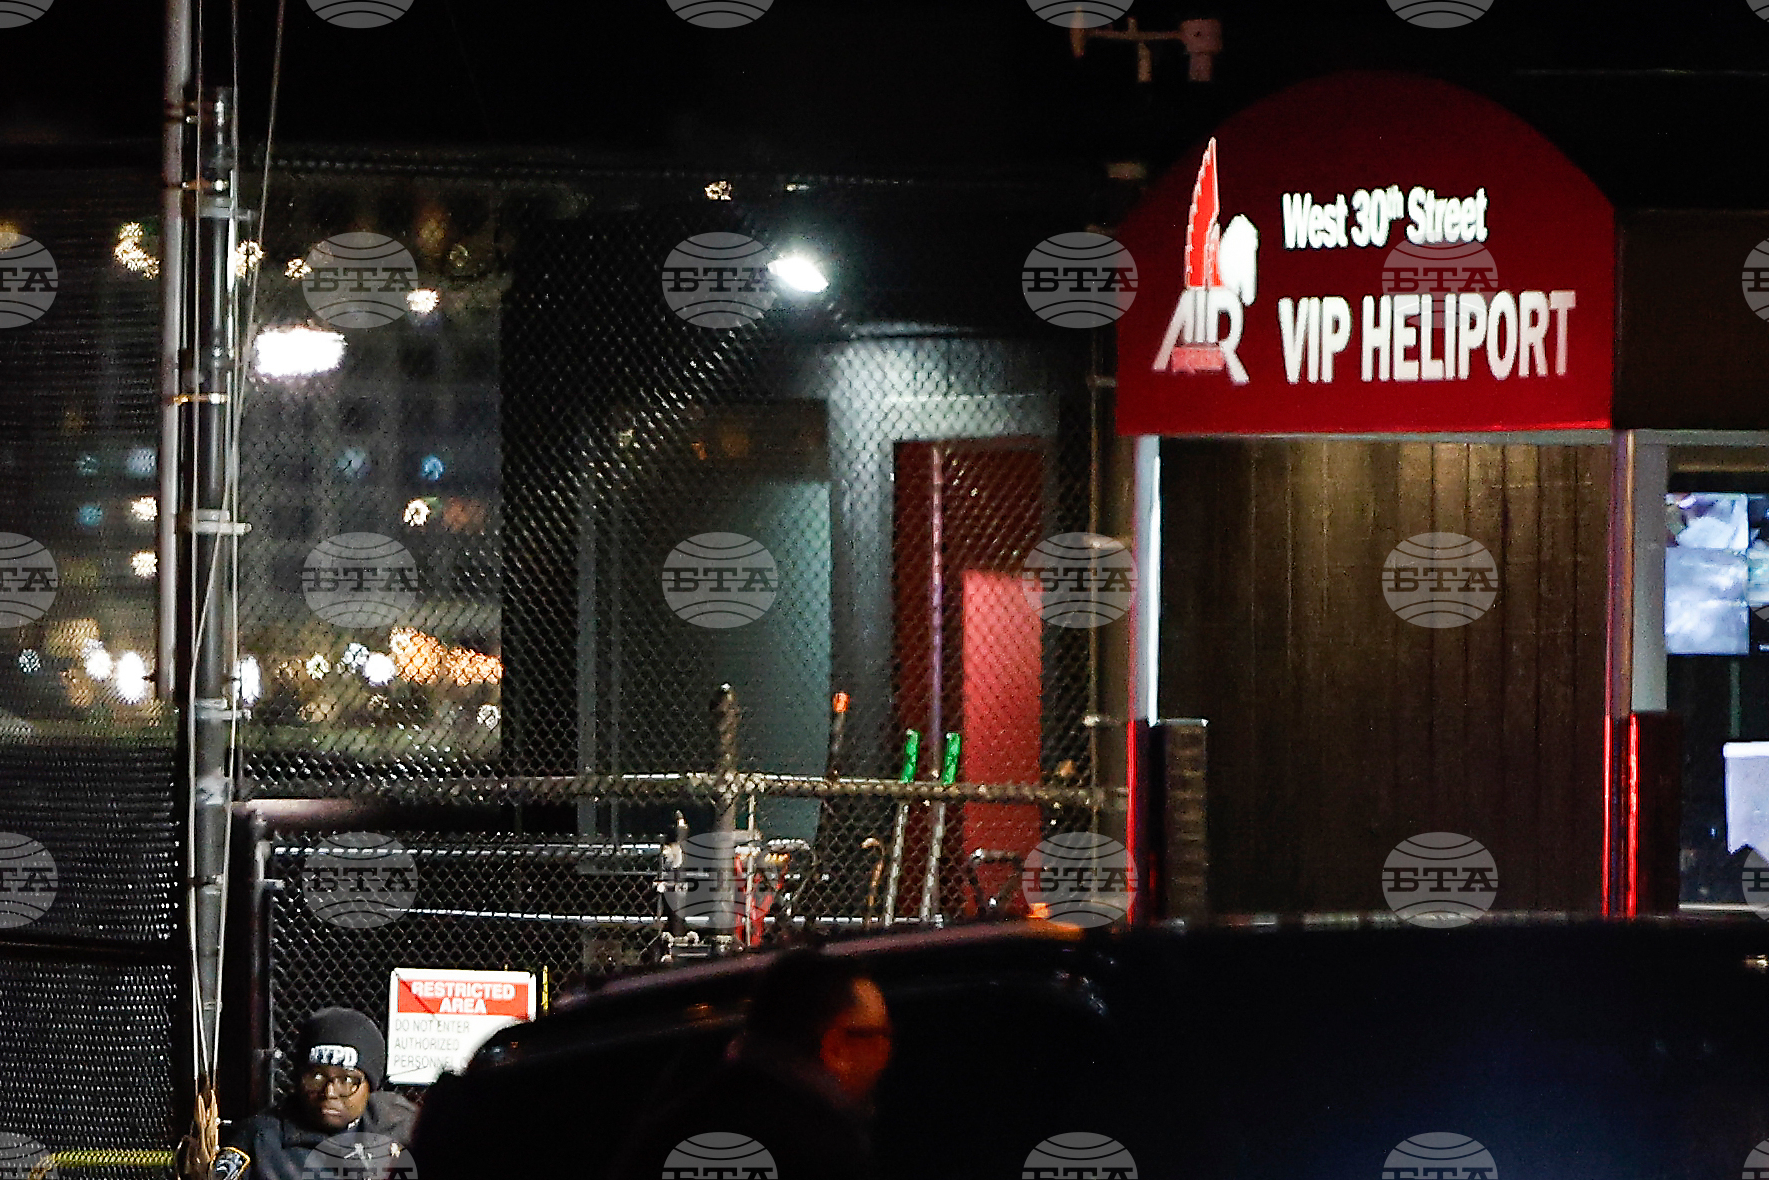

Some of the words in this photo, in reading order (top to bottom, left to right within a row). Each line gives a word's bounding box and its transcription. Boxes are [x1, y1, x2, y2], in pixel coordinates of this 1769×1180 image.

[1282, 192, 1349, 249] West
[1350, 184, 1405, 247] 30th
[1406, 185, 1489, 244] Street
[1278, 296, 1352, 384] VIP
[1360, 289, 1576, 382] HELIPORT
[411, 980, 517, 1000] RESTRICTED
[439, 997, 488, 1014] AREA
[394, 1018, 410, 1032] DO
[413, 1019, 434, 1033] NOT
[437, 1020, 470, 1034] ENTER
[394, 1036, 460, 1051] AUTHORIZED
